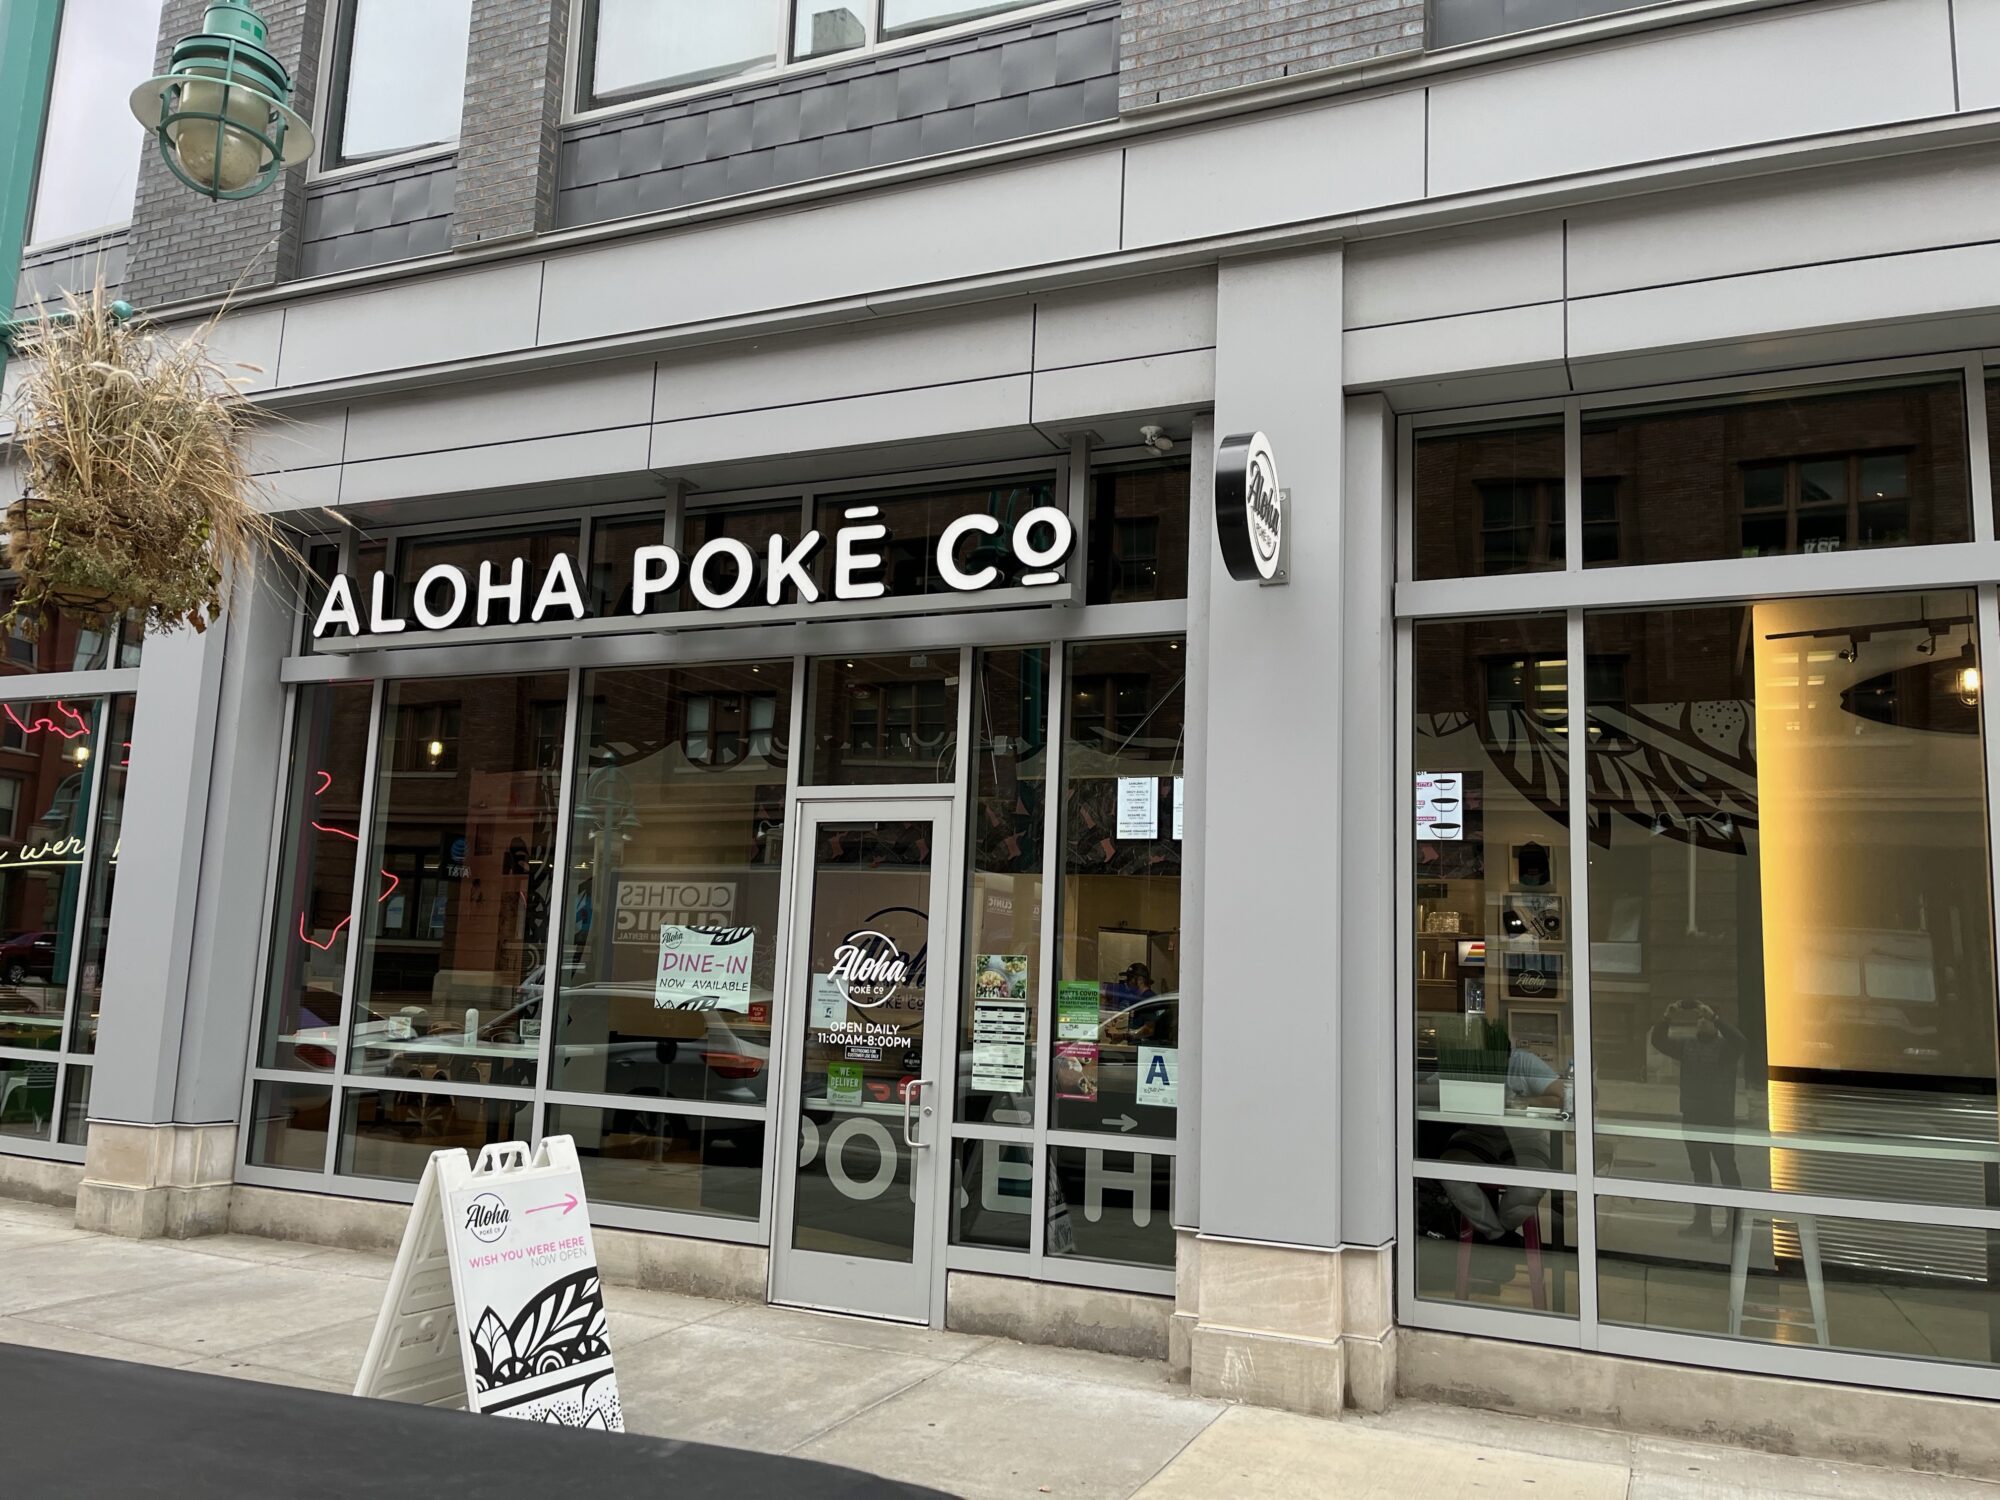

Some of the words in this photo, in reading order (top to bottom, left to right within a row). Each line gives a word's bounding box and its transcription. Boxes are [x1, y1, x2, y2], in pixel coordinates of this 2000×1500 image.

[1247, 461, 1279, 536] Aloha
[313, 552, 586, 638] ALOHA
[20, 836, 85, 860] wer
[662, 953, 748, 974] DINE-IN
[827, 944, 907, 982] Aloha
[659, 978, 685, 988] NOW
[692, 980, 748, 992] AVAILABLE
[830, 1021, 862, 1033] OPEN
[866, 1022, 900, 1035] DAILY
[818, 1032, 911, 1048] 11:00AM-8:00PM
[840, 1067, 850, 1076] WE
[1145, 1055, 1171, 1086] A
[831, 1076, 859, 1089] DELIVER
[465, 1203, 511, 1229] Aloha
[469, 1254, 498, 1268] WISH
[500, 1249, 523, 1261] YOU
[526, 1242, 556, 1257] WERE
[559, 1236, 585, 1250] HERE
[530, 1253, 557, 1268] NOW
[560, 1246, 587, 1262] OPEN
